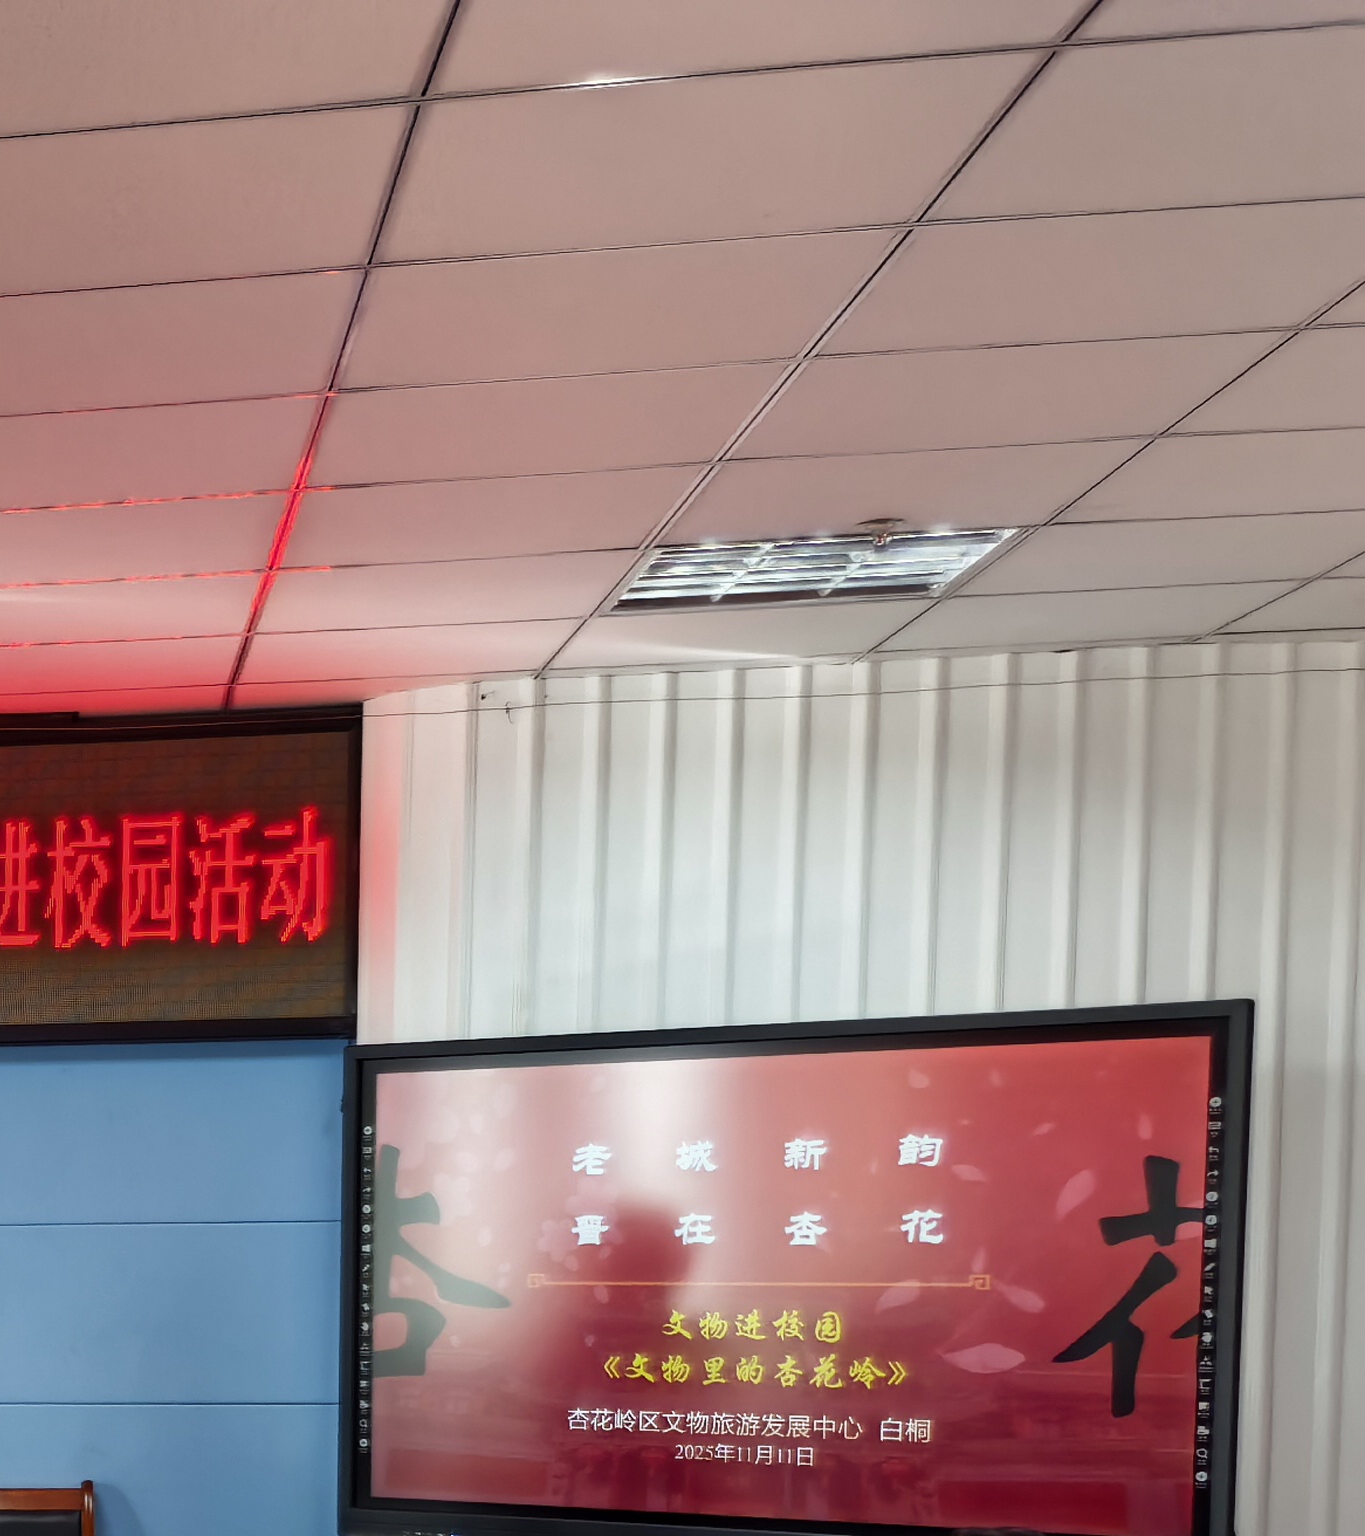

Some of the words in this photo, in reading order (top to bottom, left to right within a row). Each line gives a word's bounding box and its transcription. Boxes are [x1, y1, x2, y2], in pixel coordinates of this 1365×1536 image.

[662, 1310, 842, 1343] 文物进校园
[603, 1353, 909, 1389] 《文物里的杏花岭》
[567, 1408, 863, 1440] 杏花岭区文物旅游发展中心
[880, 1417, 932, 1443] 白桐
[674, 1443, 815, 1467] 2025年11月11日
